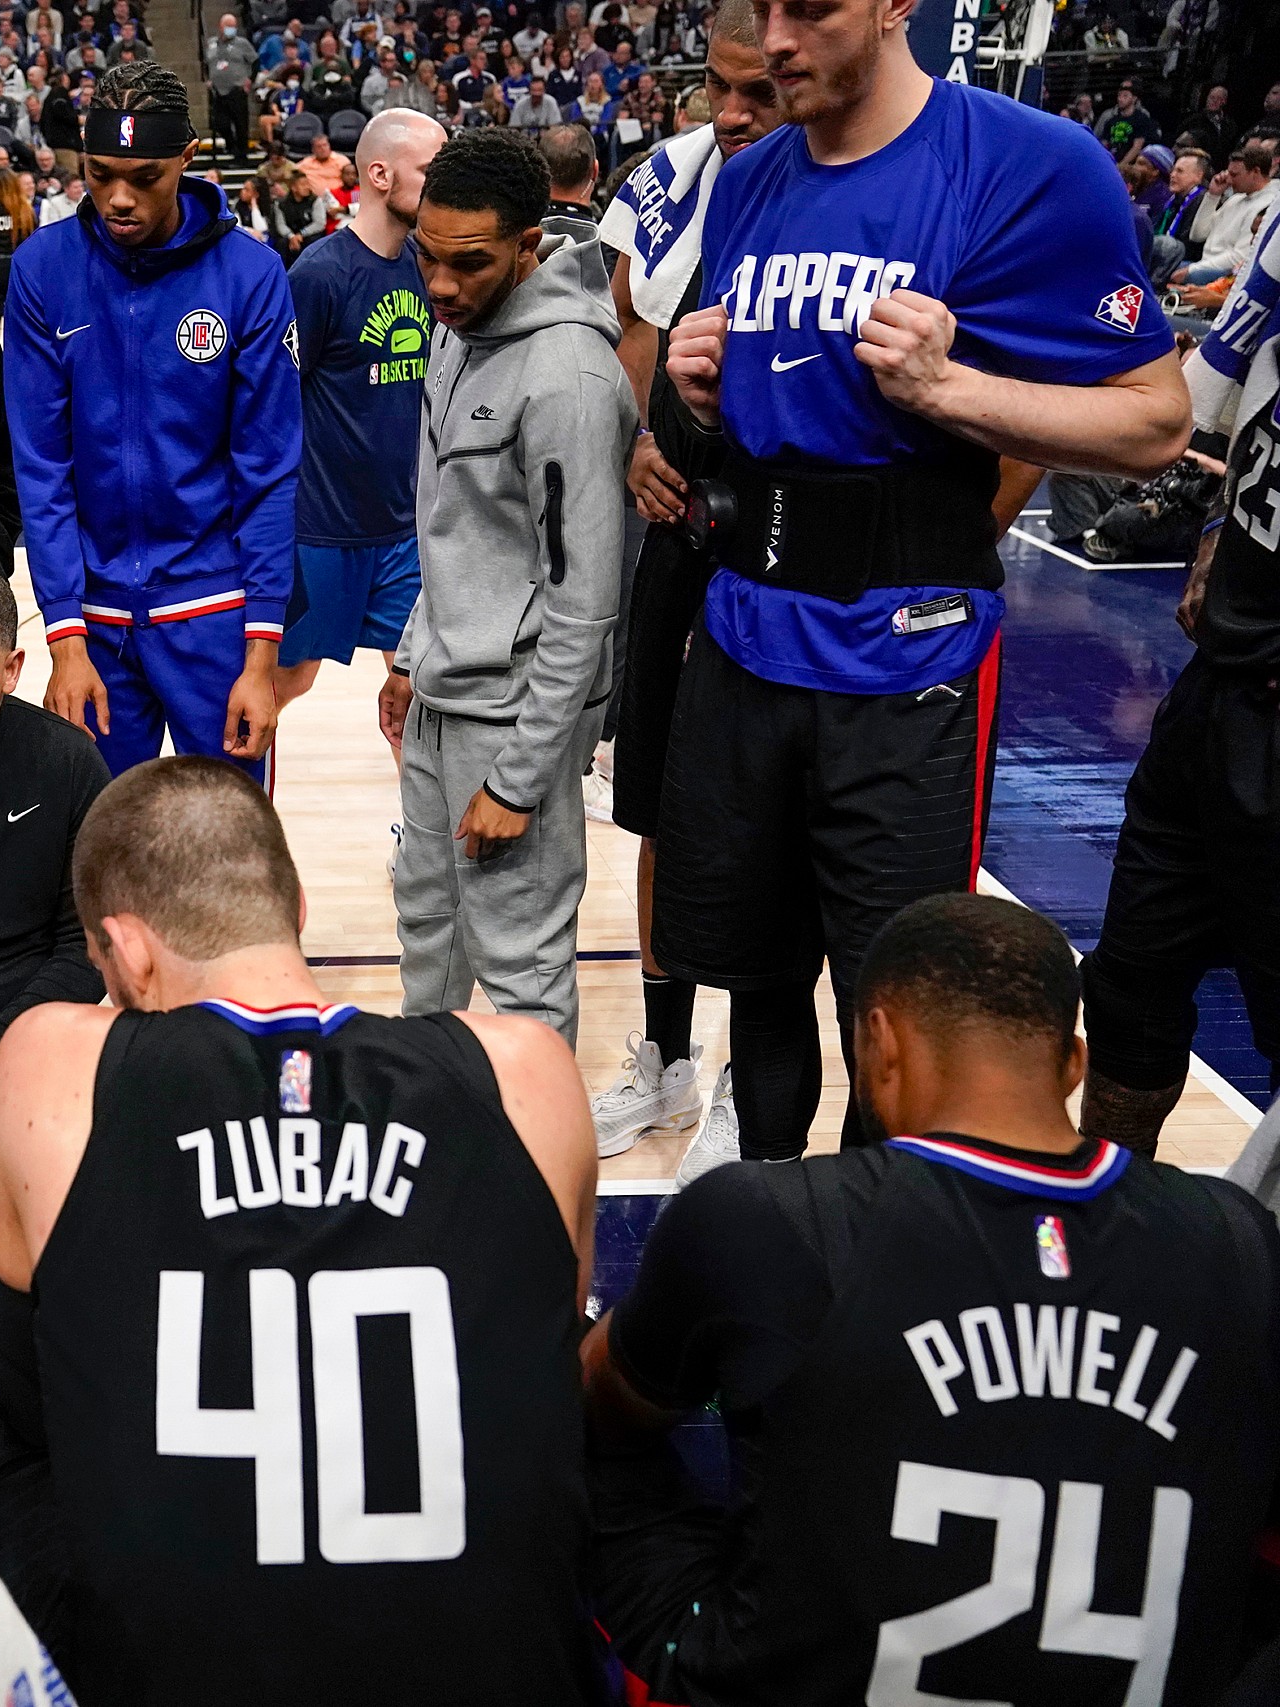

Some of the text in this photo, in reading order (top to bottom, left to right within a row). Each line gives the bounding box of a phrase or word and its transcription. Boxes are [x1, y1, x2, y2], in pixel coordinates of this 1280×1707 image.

[945, 0, 981, 85] NBA
[476, 404, 495, 418] NIKE
[770, 489, 783, 547] VENOM
[176, 1116, 426, 1220] ZUBAC
[155, 1266, 466, 1565] 40
[903, 1303, 1199, 1441] POWELL
[865, 1461, 1192, 1707] 24
